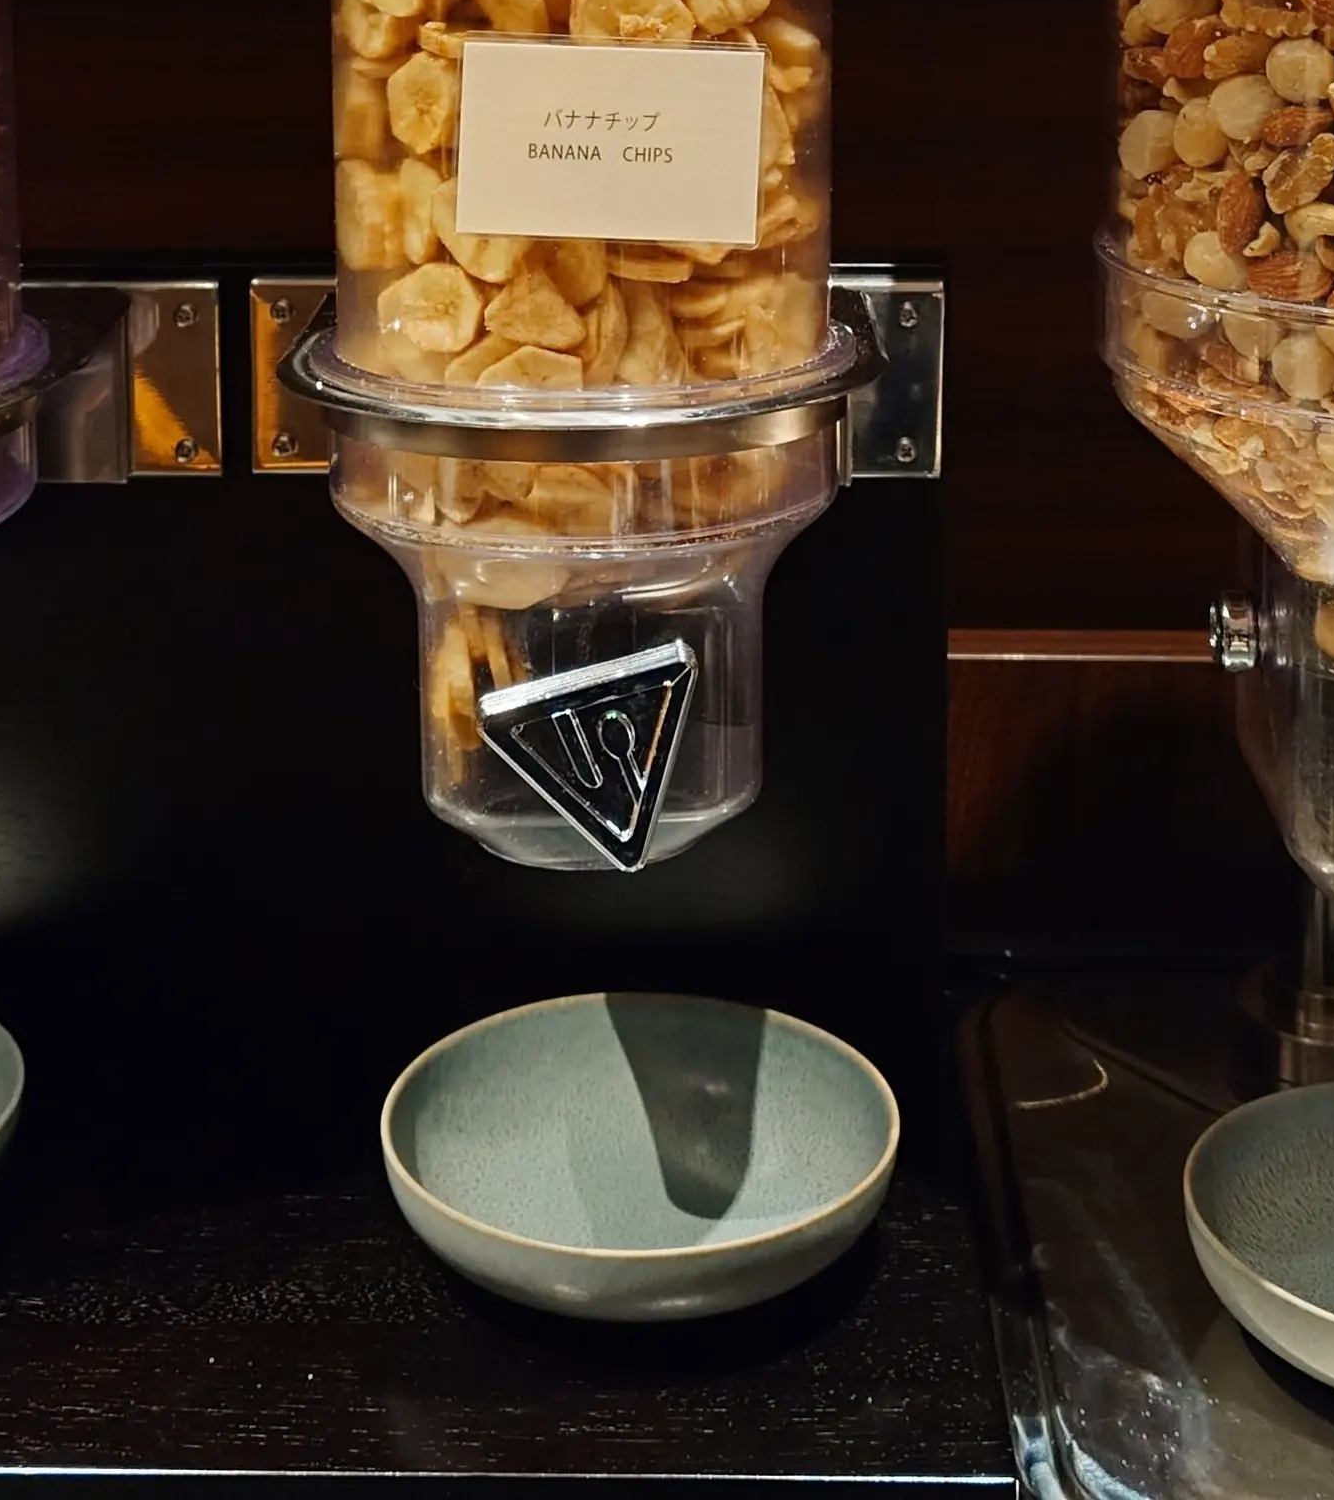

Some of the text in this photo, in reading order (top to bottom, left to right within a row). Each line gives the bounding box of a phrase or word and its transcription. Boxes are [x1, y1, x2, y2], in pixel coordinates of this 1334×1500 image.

[543, 108, 662, 131] バナナチップ
[527, 142, 673, 163] BANANA CHIPS
